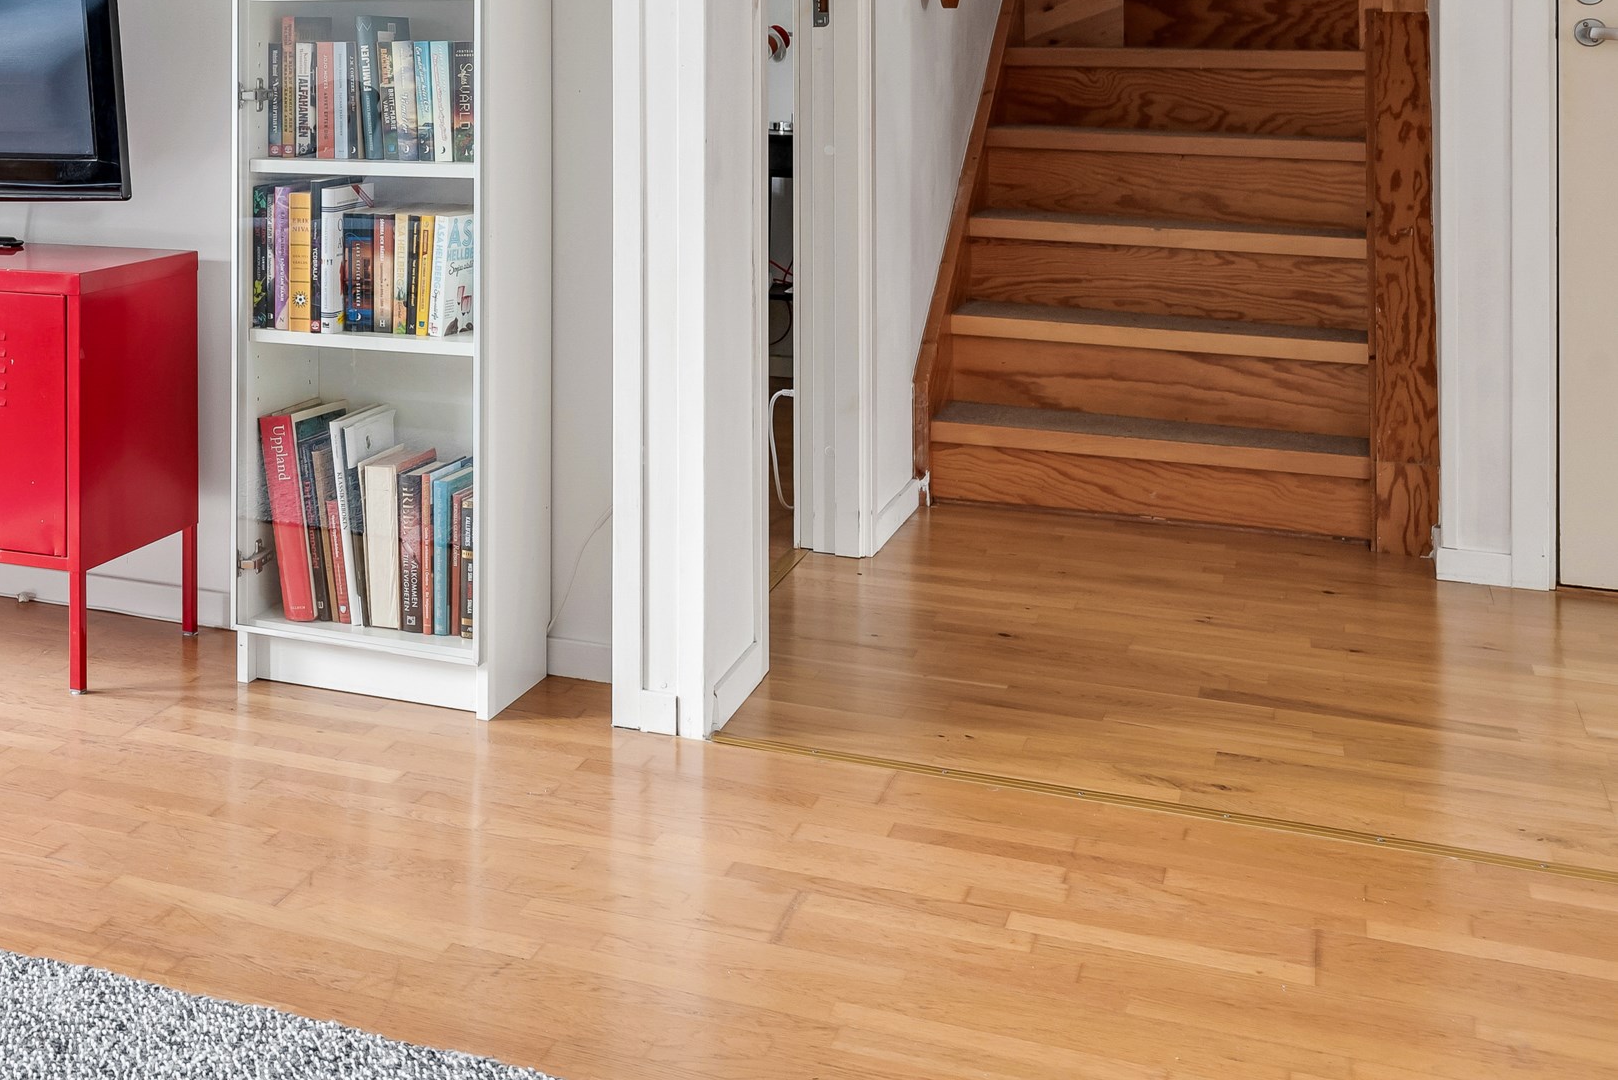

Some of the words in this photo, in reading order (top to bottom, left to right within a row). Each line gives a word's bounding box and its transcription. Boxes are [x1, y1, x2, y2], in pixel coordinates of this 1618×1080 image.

[361, 45, 372, 91] FAMILJEN
[298, 78, 308, 138] ALFAHANNEN
[388, 88, 396, 130] BRITT-MARIE
[459, 85, 472, 130] VÄRLD
[397, 217, 407, 237] ÅSA
[437, 223, 446, 243] ÅSA
[447, 218, 474, 249] ÅS
[397, 239, 407, 285] HELLBERG
[434, 244, 444, 289] HELLBERG
[270, 424, 290, 480] Uppland
[337, 472, 348, 530] KLASSIKERBOKEN
[410, 560, 418, 608] VÄLKOMMEN
